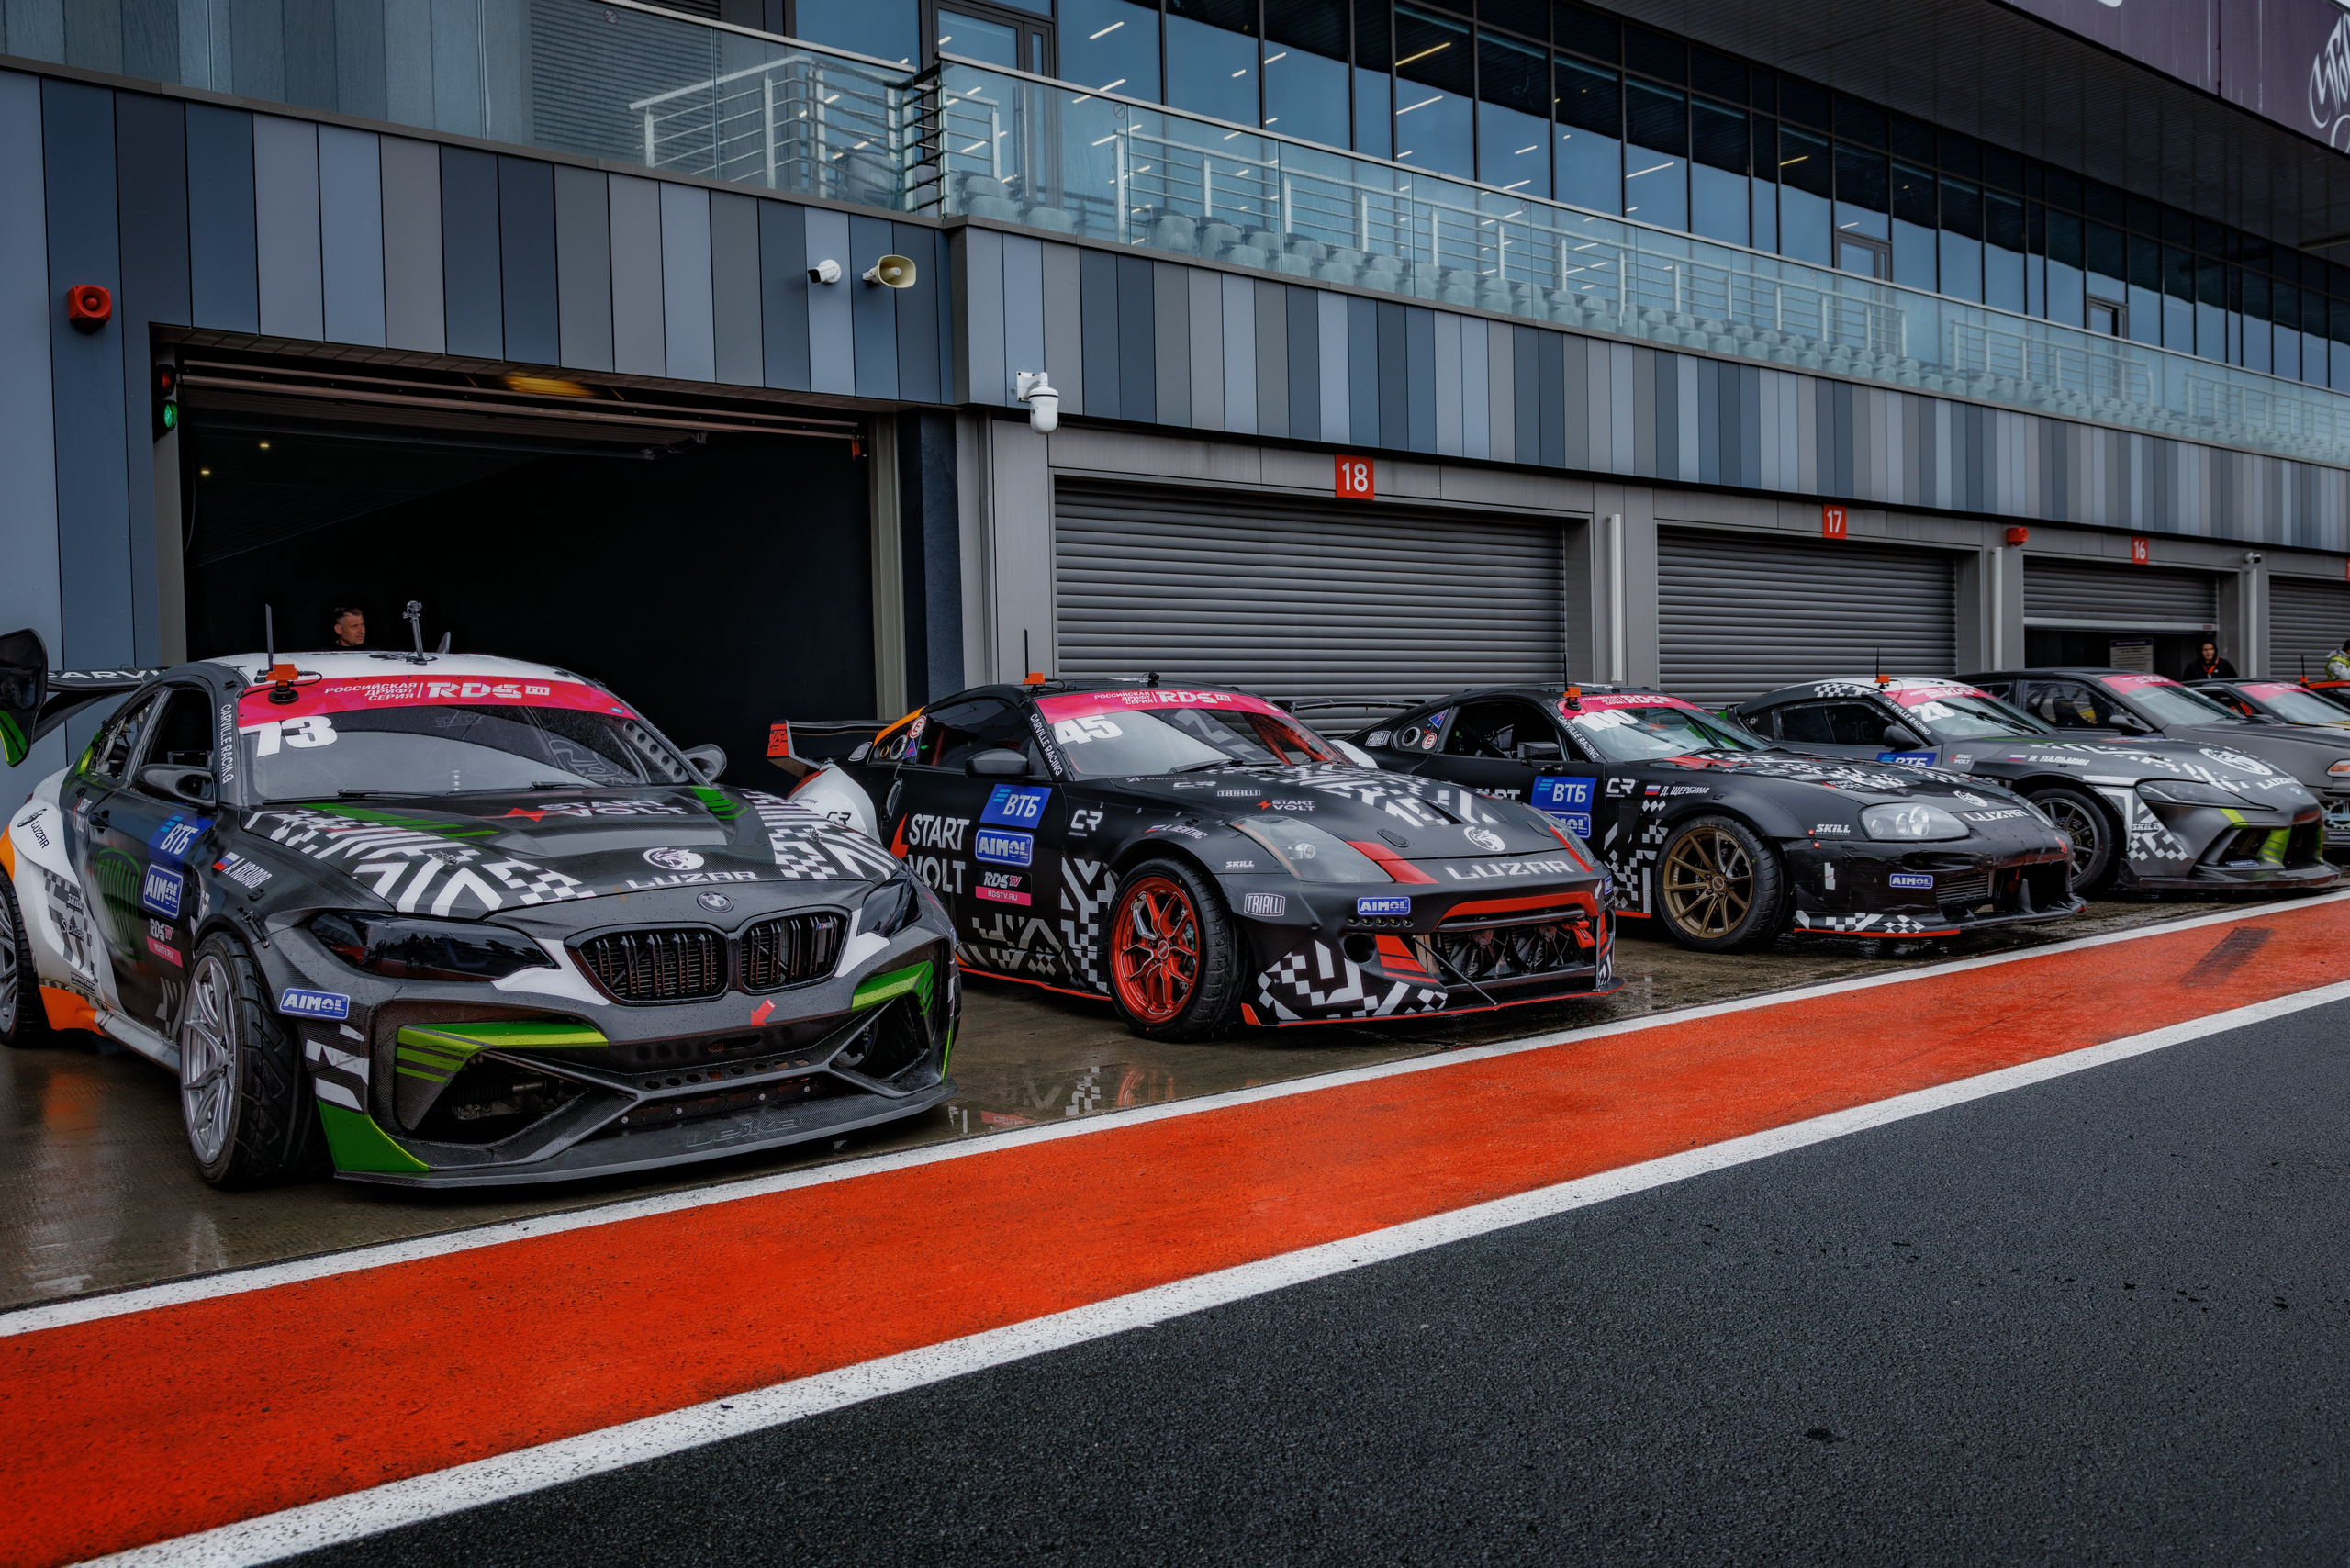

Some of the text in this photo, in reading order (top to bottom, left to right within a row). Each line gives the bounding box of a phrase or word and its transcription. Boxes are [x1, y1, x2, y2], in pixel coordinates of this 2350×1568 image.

[1341, 462, 1368, 492] 18
[1827, 510, 1842, 533] 17
[2133, 540, 2146, 560] 16
[325, 682, 418, 694] РОССИЙСКАЯ
[364, 688, 415, 696] ДРИФТ
[368, 693, 414, 701] СЕРИЯ
[426, 682, 522, 699] RDS
[1156, 691, 1218, 703] RDS
[1620, 695, 1665, 704] RDS
[1571, 709, 1639, 732] 100
[1885, 699, 1931, 735] CARVILLE RACING
[1055, 715, 1123, 745] 45
[1558, 716, 1600, 759] CARVILLE RACING
[220, 703, 234, 785] CARVILLE RACING
[1030, 713, 1064, 778] CARVILLE RACING
[2039, 756, 2090, 766] ПАЛЬМИН
[1552, 783, 1587, 803] ВТБ
[1606, 778, 1636, 794] CR
[1660, 786, 1711, 797] Д. ЩЕРБИНА
[538, 801, 666, 811] START
[559, 807, 688, 817] VOLT
[1002, 793, 1041, 818] ВТБ
[1963, 809, 2030, 821] LUZAR
[1070, 809, 1103, 831] CR
[1815, 823, 1851, 833] SKILL
[30, 820, 50, 849] LUZAR
[160, 823, 199, 855] ВТБ
[908, 813, 970, 851] START
[977, 836, 1029, 858] AIMOL
[229, 861, 273, 889] КОЗЛОВ
[625, 871, 760, 889] LUZAR
[909, 854, 966, 895] VOLT
[1444, 860, 1576, 880] LUZAR
[145, 874, 178, 906] AIMOL
[1891, 875, 1931, 886] AIMOL
[988, 890, 1018, 902] RDSTV.RU
[1248, 894, 1283, 914] TRIALLI
[1360, 900, 1408, 913] AIMOL
[283, 994, 347, 1013] AIMOL
